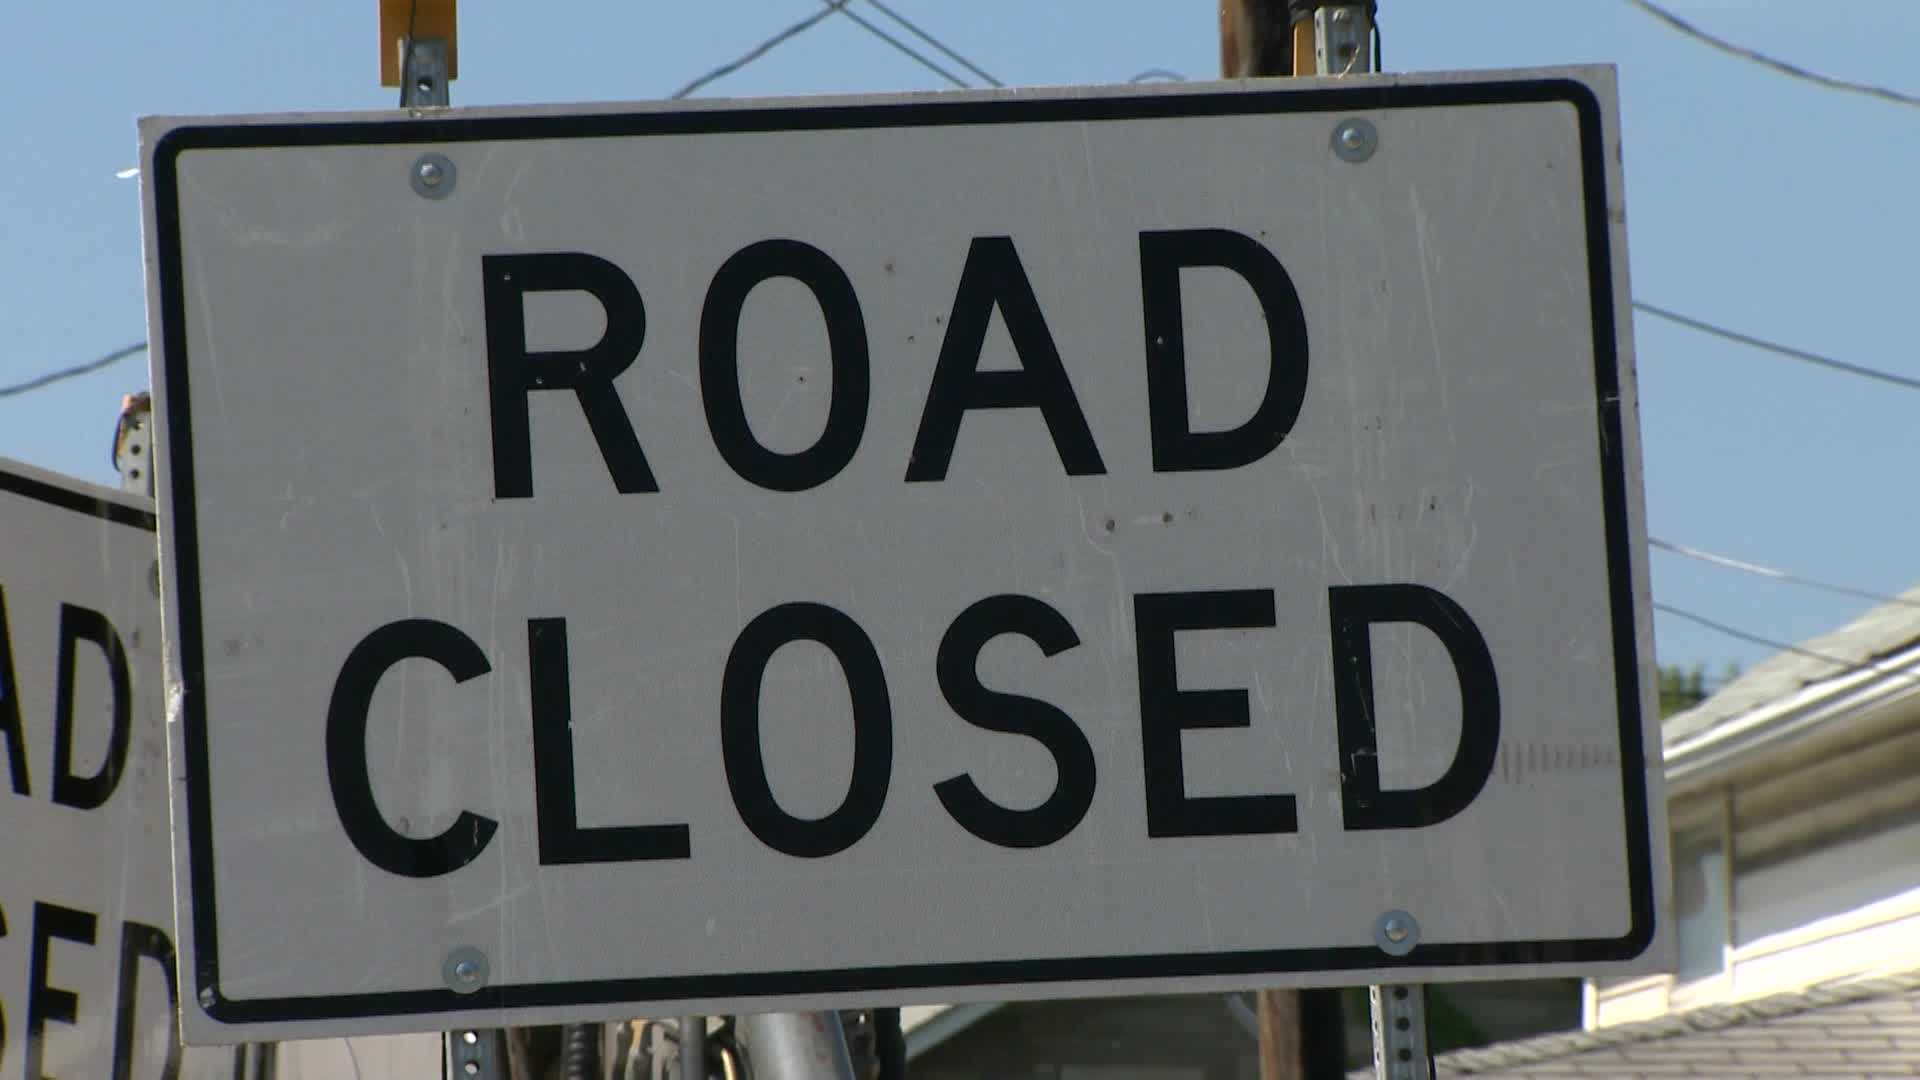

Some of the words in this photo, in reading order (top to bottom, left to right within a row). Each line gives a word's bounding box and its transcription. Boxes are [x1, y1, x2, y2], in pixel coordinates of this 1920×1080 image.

[482, 228, 1310, 500] ROAD
[326, 583, 1502, 879] CLOSED
[0, 900, 182, 1080] ED
